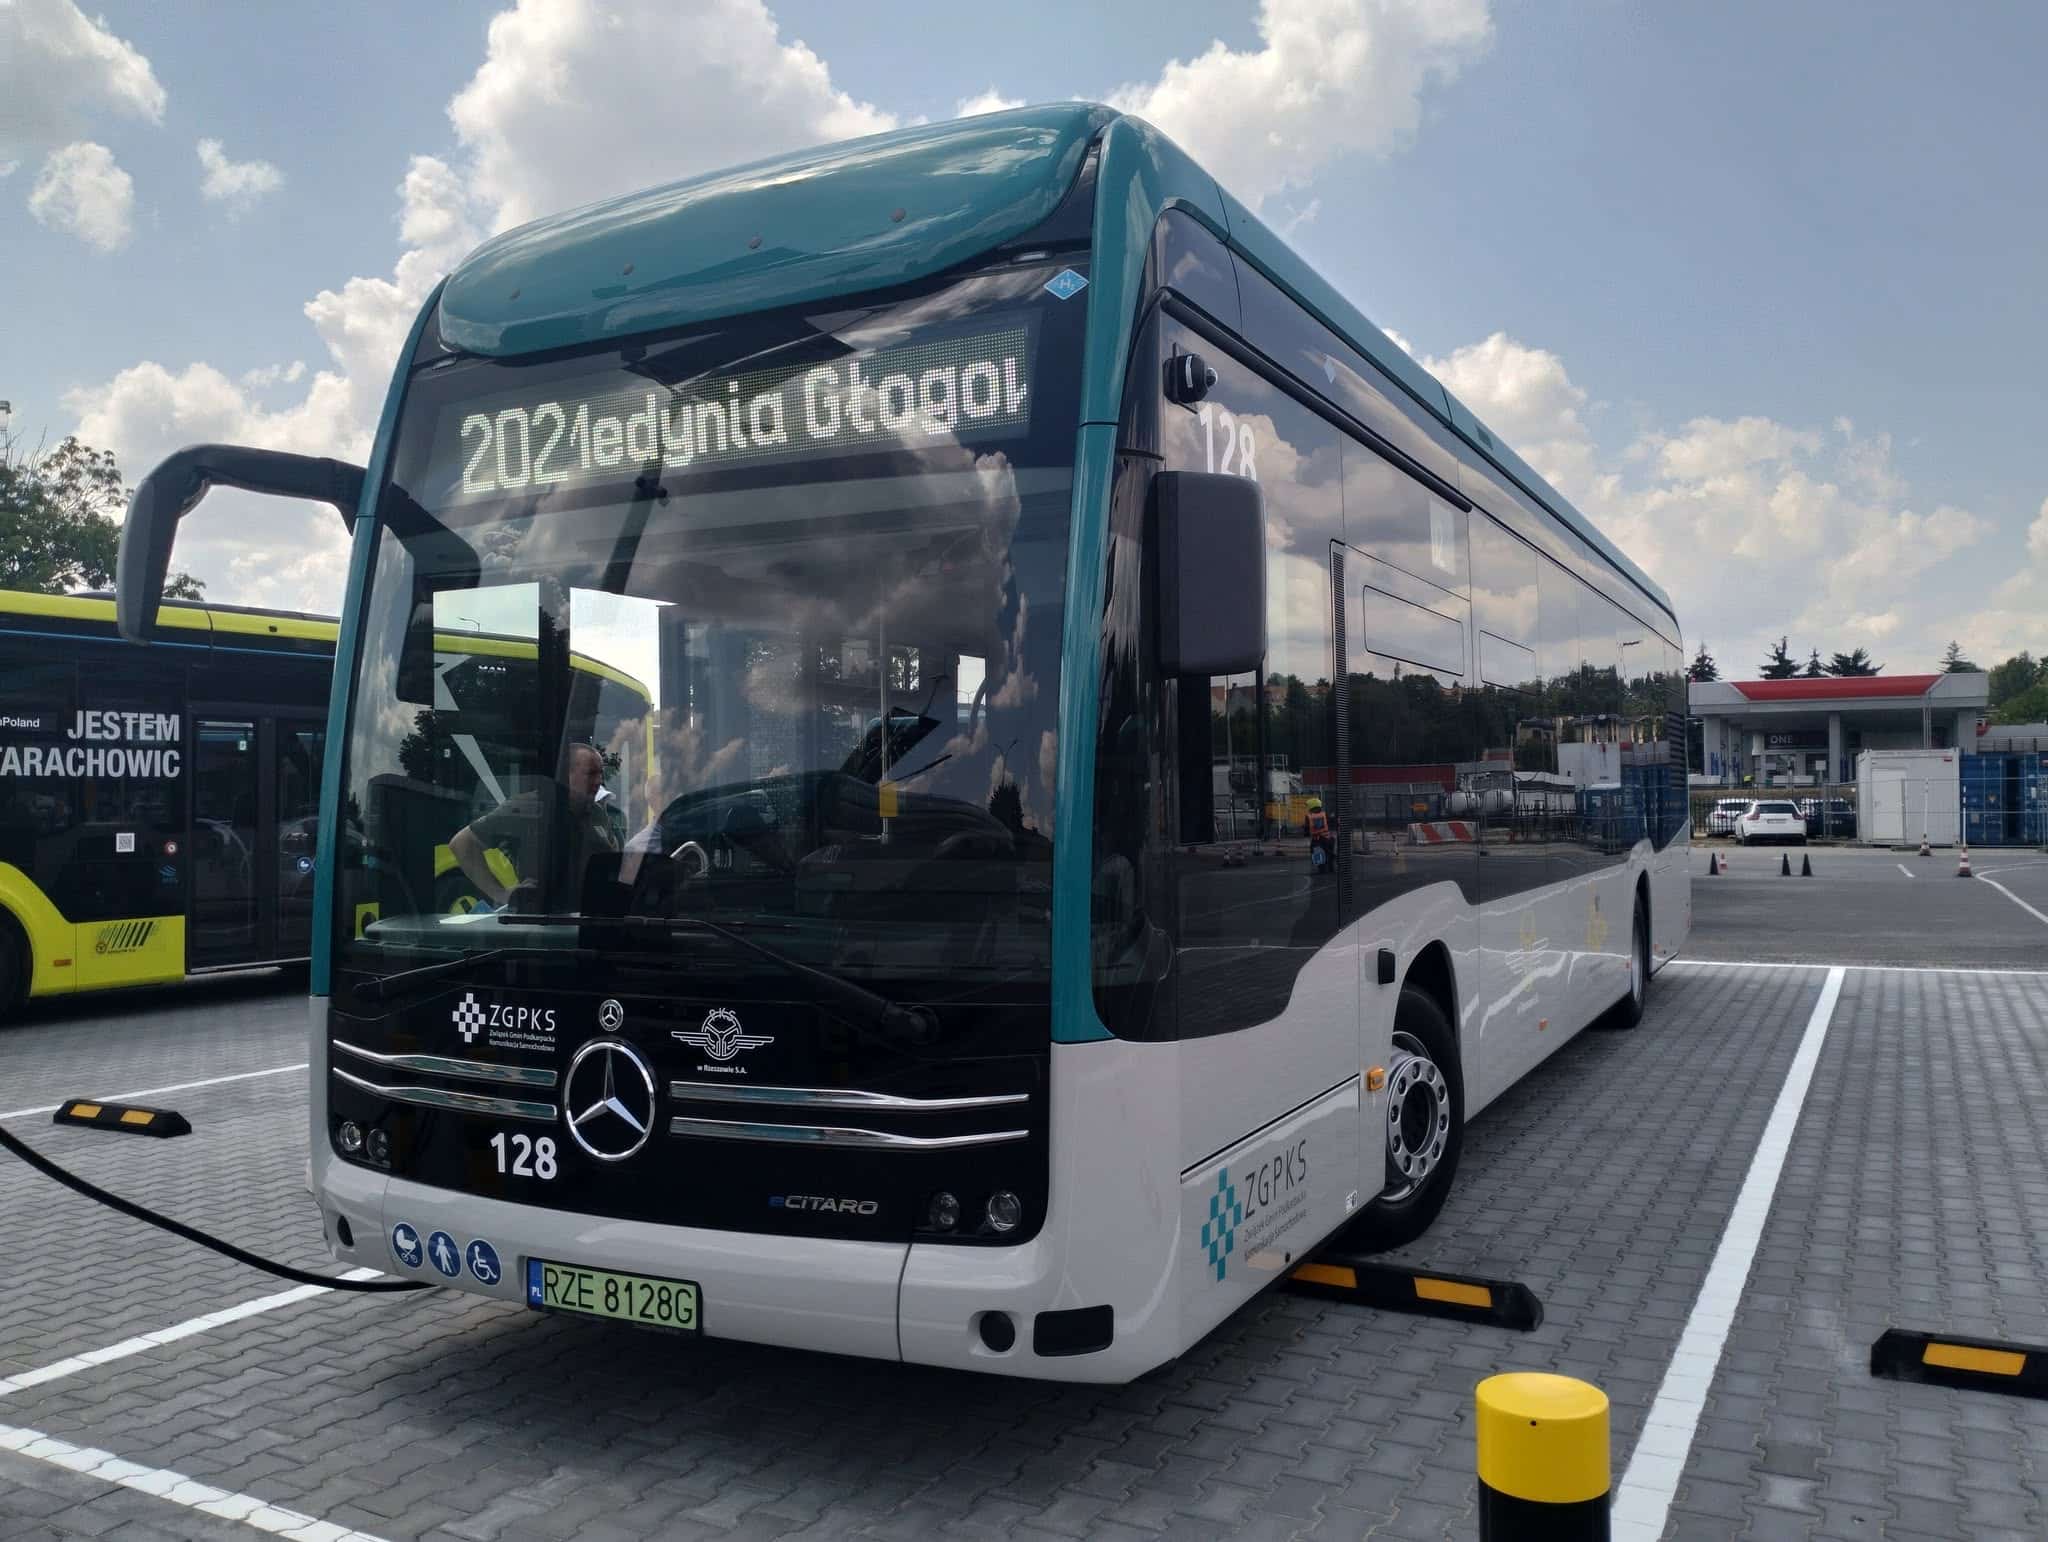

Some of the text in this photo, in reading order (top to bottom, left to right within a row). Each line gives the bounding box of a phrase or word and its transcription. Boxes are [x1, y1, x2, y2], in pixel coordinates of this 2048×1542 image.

[67, 710, 180, 742] JESTEM
[489, 1004, 556, 1032] ZGPKS
[490, 1132, 558, 1180] 128
[1244, 1138, 1307, 1220] ZGPKS
[543, 1267, 694, 1325] RZE 8128G
